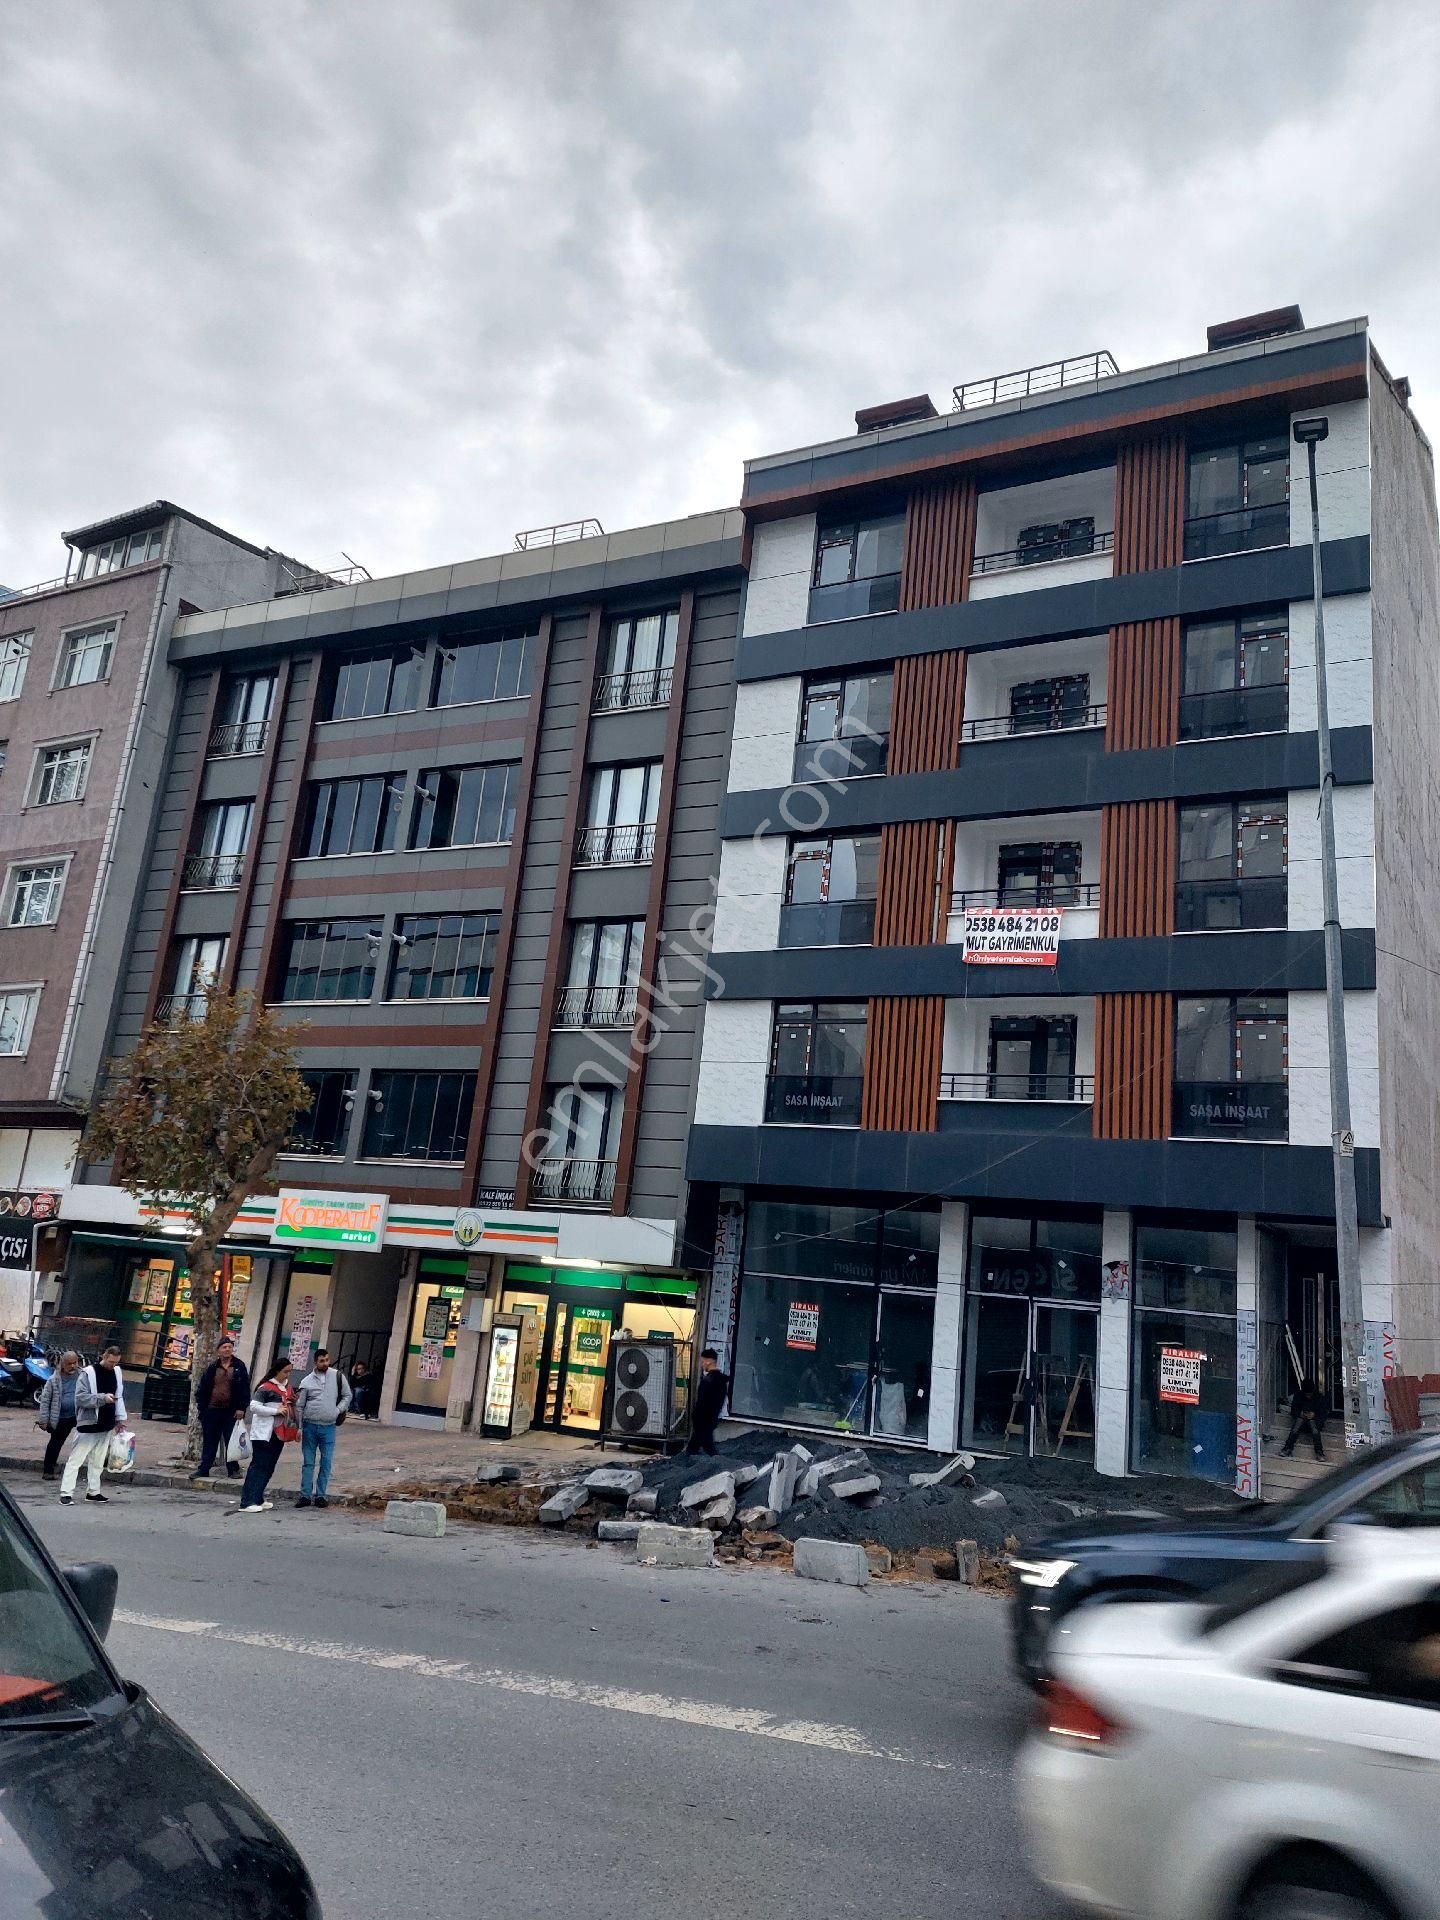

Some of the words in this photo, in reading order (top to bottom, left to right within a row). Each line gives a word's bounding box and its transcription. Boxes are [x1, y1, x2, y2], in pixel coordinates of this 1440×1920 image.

[966, 917, 996, 932] 0538
[998, 917, 1023, 932] 484
[1025, 917, 1038, 932] 21
[1040, 916, 1059, 932] 08
[966, 936, 988, 951] MUT
[988, 931, 1057, 952] GAYRİMENKUL
[785, 1095, 808, 1106] SASA
[810, 1092, 844, 1109] İNŞAAT
[1189, 1104, 1222, 1118] SASA
[1225, 1102, 1271, 1121] İNŞAAT
[341, 1231, 372, 1243] market
[0, 1235, 28, 1261] ÇİSİ
[1168, 1379, 1193, 1388] UMUT
[1236, 1414, 1252, 1493] SARAY
